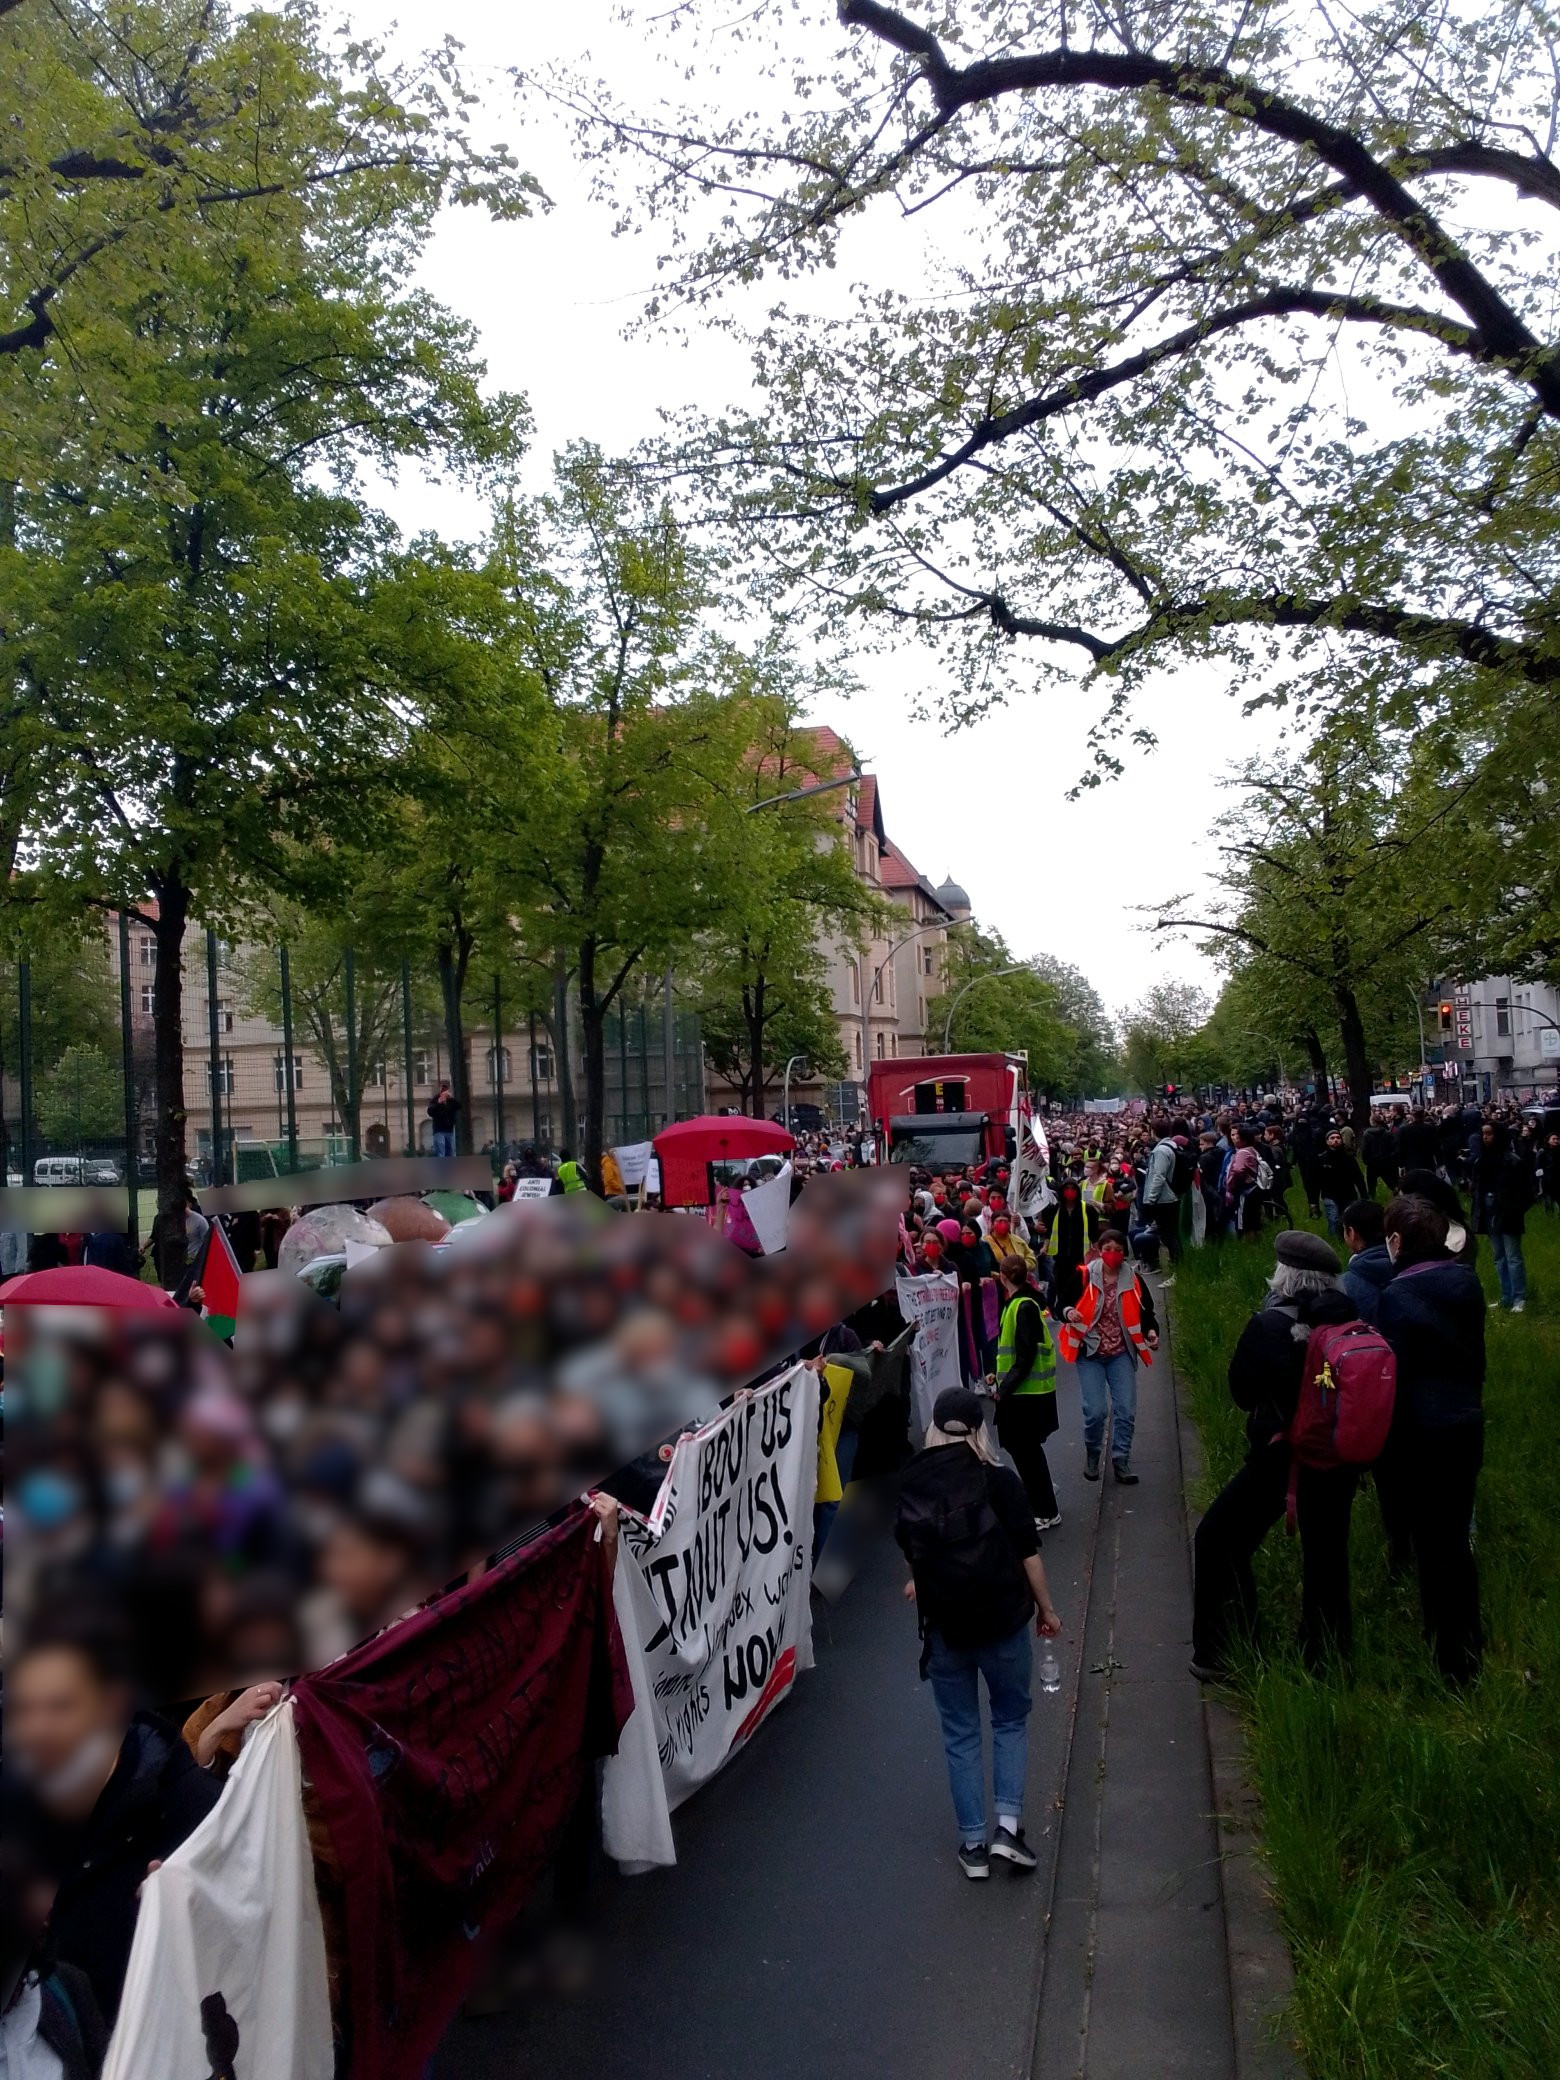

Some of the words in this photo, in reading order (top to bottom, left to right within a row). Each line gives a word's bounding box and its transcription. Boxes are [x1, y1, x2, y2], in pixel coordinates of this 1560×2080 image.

[761, 1381, 792, 1458] US
[737, 1461, 793, 1563] US!
[675, 1682, 709, 1755] rights
